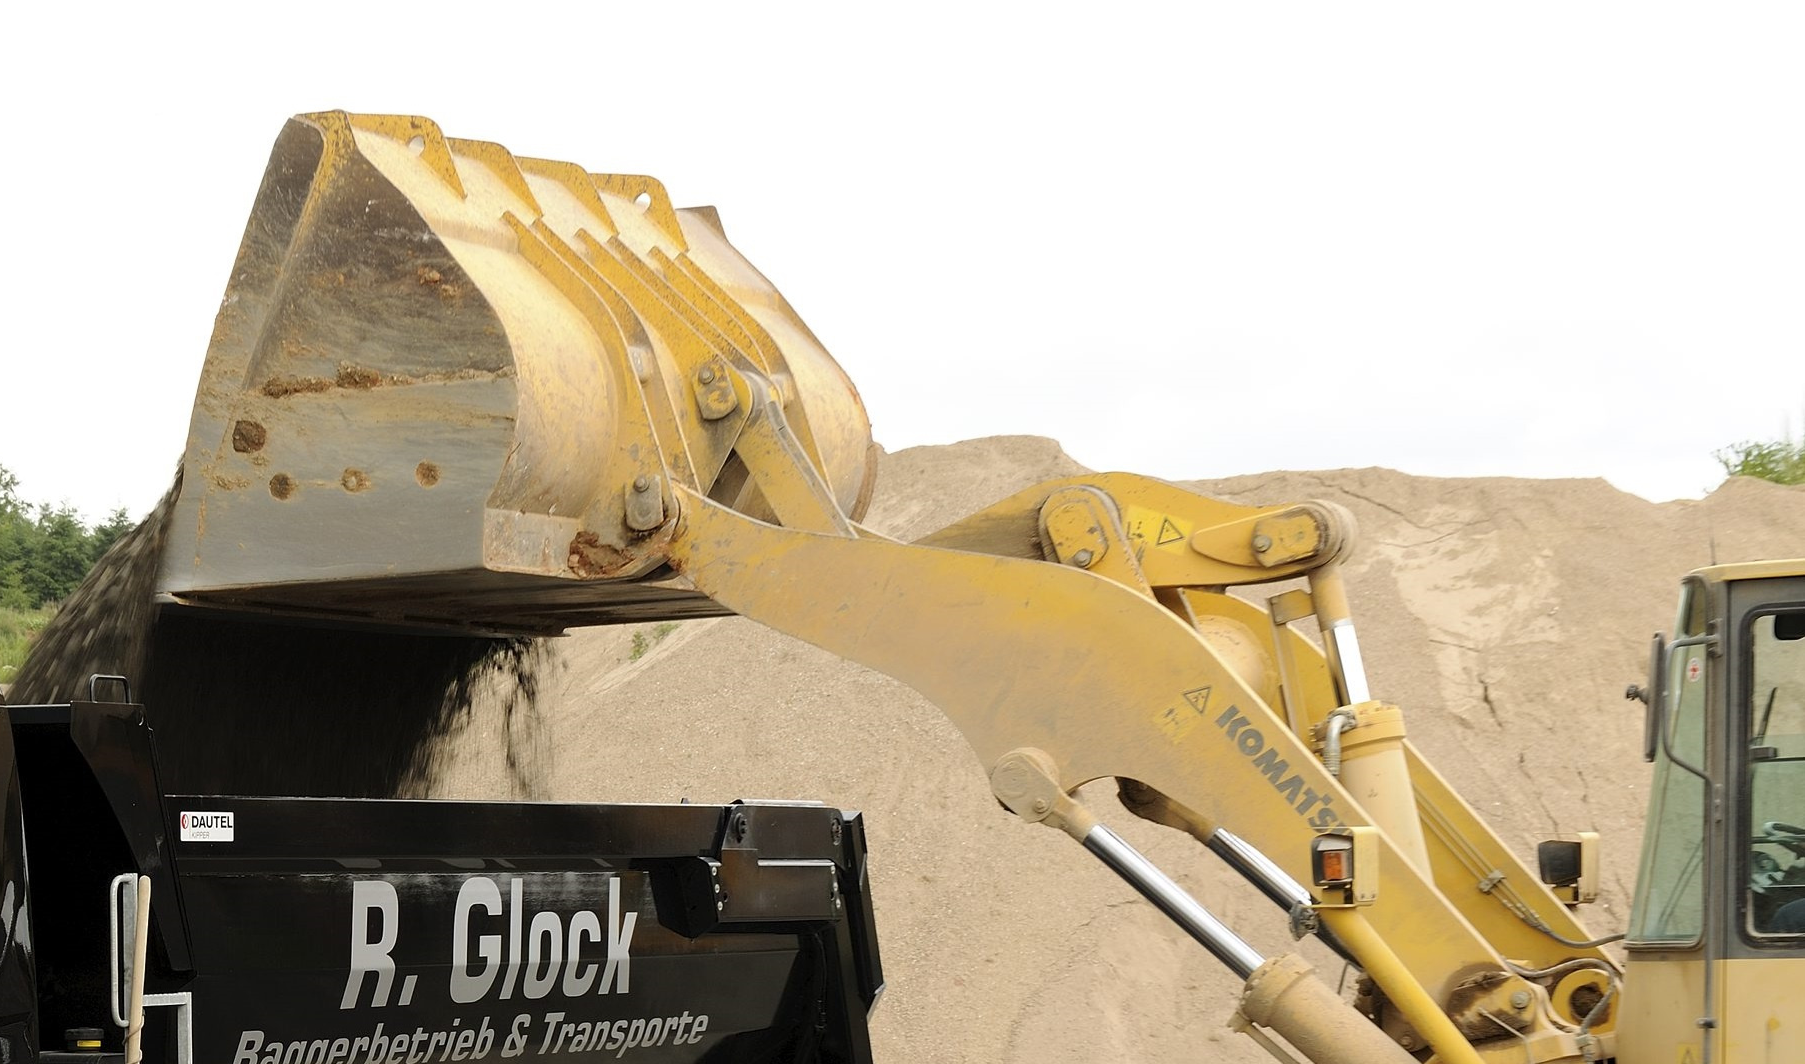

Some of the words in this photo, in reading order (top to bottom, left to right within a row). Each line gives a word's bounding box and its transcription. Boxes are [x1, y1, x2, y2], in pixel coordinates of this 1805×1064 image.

[1215, 704, 1353, 838] KOMATS
[191, 815, 233, 829] DAUTEL
[339, 880, 418, 1010] R.
[449, 876, 638, 1004] Glock
[500, 1013, 531, 1059] &
[537, 1010, 709, 1059] Transporte
